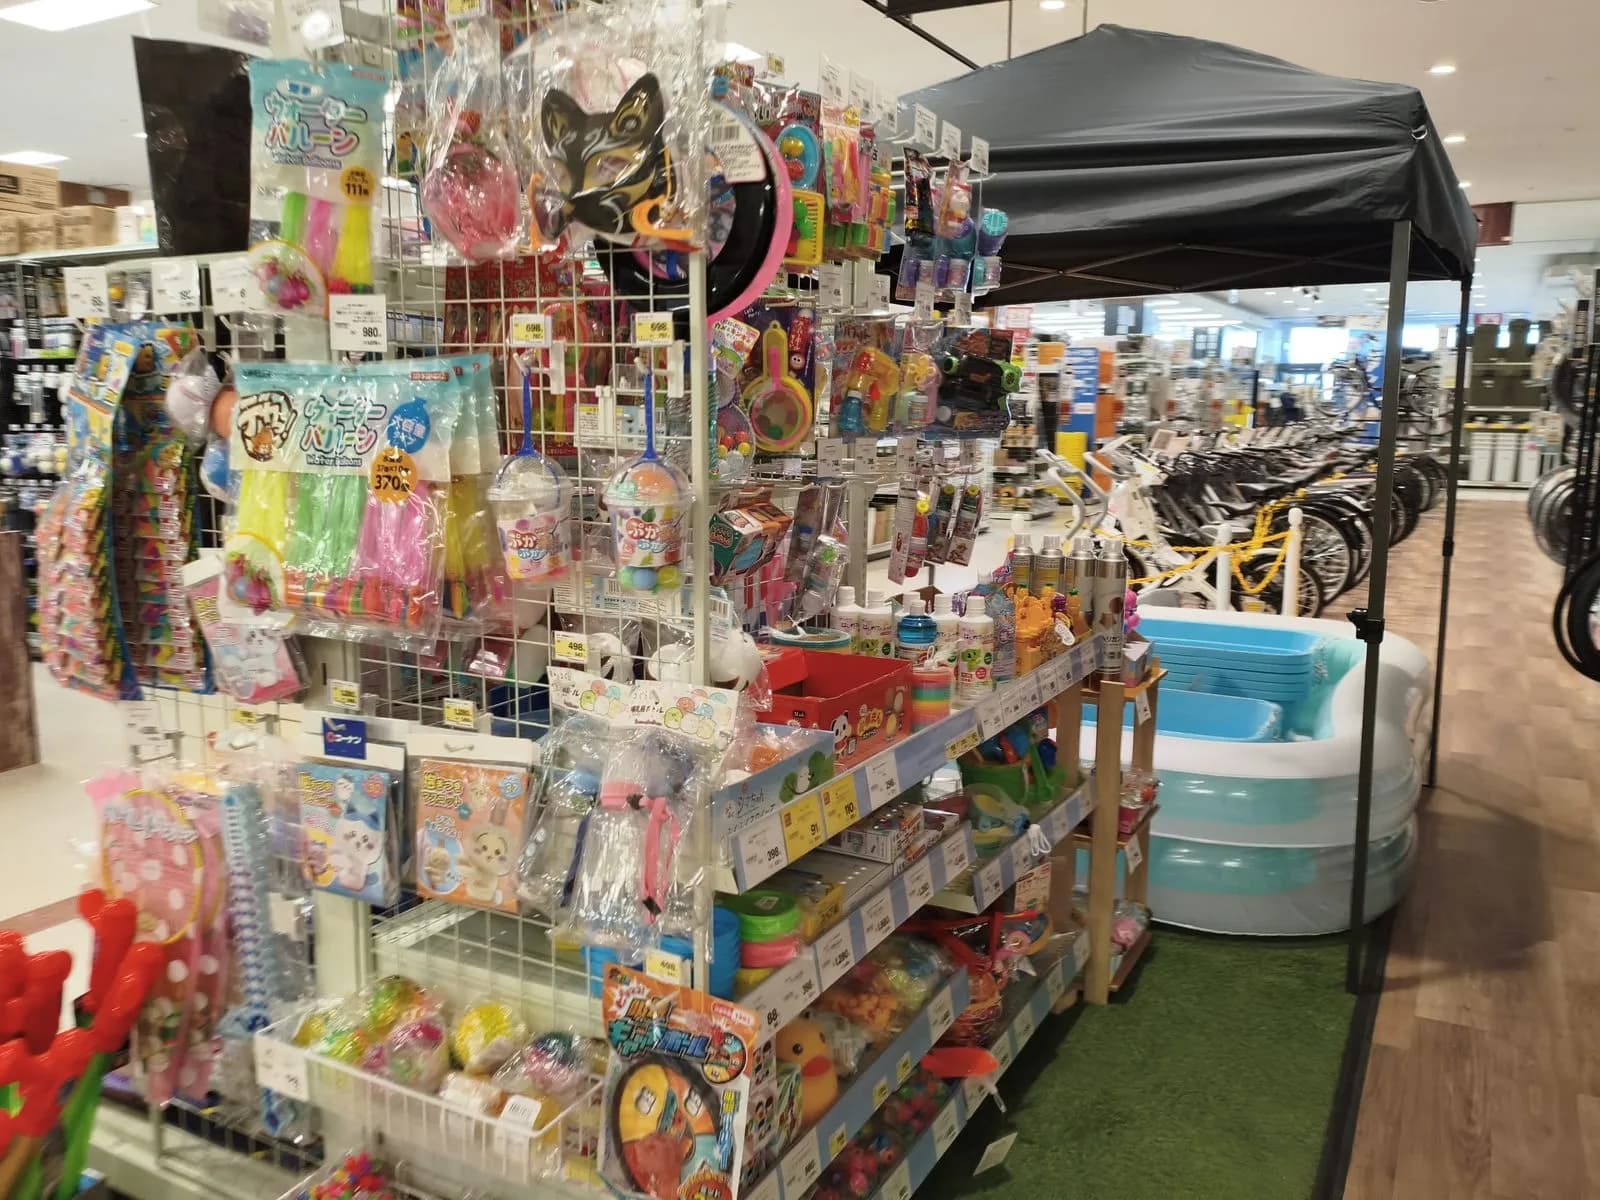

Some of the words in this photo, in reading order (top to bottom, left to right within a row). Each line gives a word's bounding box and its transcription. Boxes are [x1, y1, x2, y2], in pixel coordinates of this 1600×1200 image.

[362, 326, 379, 337] 980
[567, 641, 583, 652] 498
[335, 734, 362, 745] コーナン
[810, 823, 819, 836] 91
[767, 1008, 778, 1025] 88
